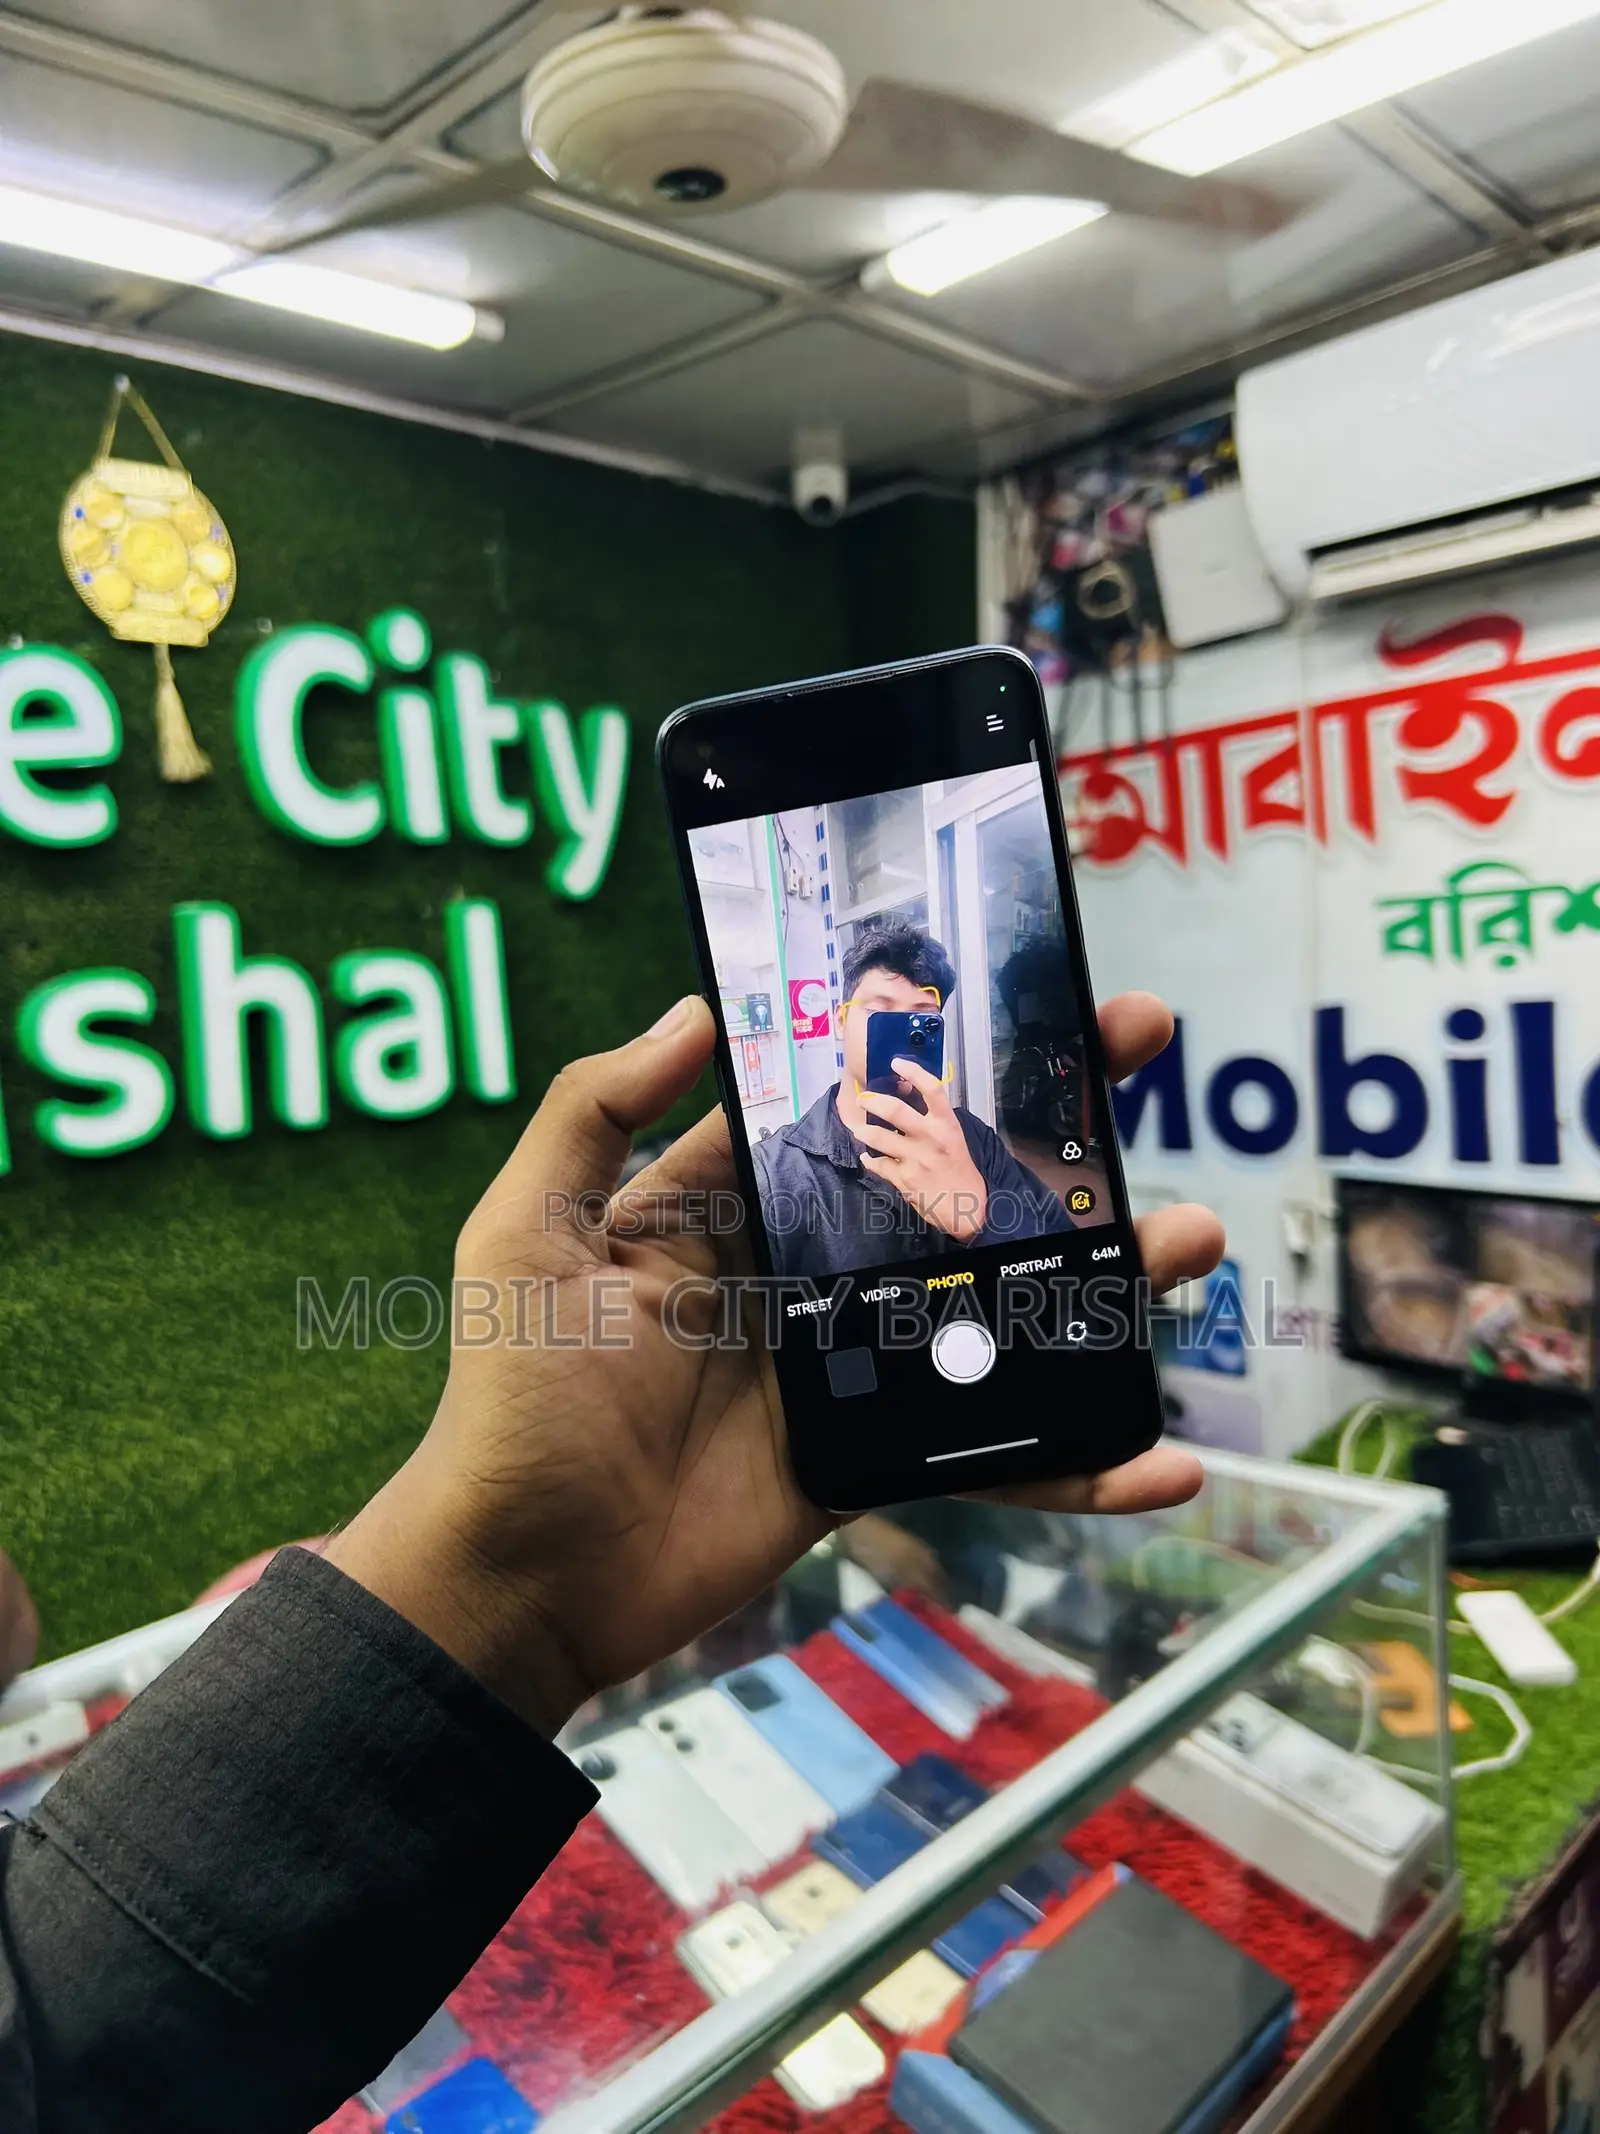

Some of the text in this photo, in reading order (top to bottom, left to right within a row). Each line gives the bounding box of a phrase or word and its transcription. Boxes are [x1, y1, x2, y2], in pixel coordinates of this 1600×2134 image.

[235, 605, 630, 899] City
[0, 896, 516, 1178] shal
[1112, 1000, 1600, 1167] Mobil
[786, 1245, 1121, 1318] STREET VIDEO PHOTO PORTRAIT 64M
